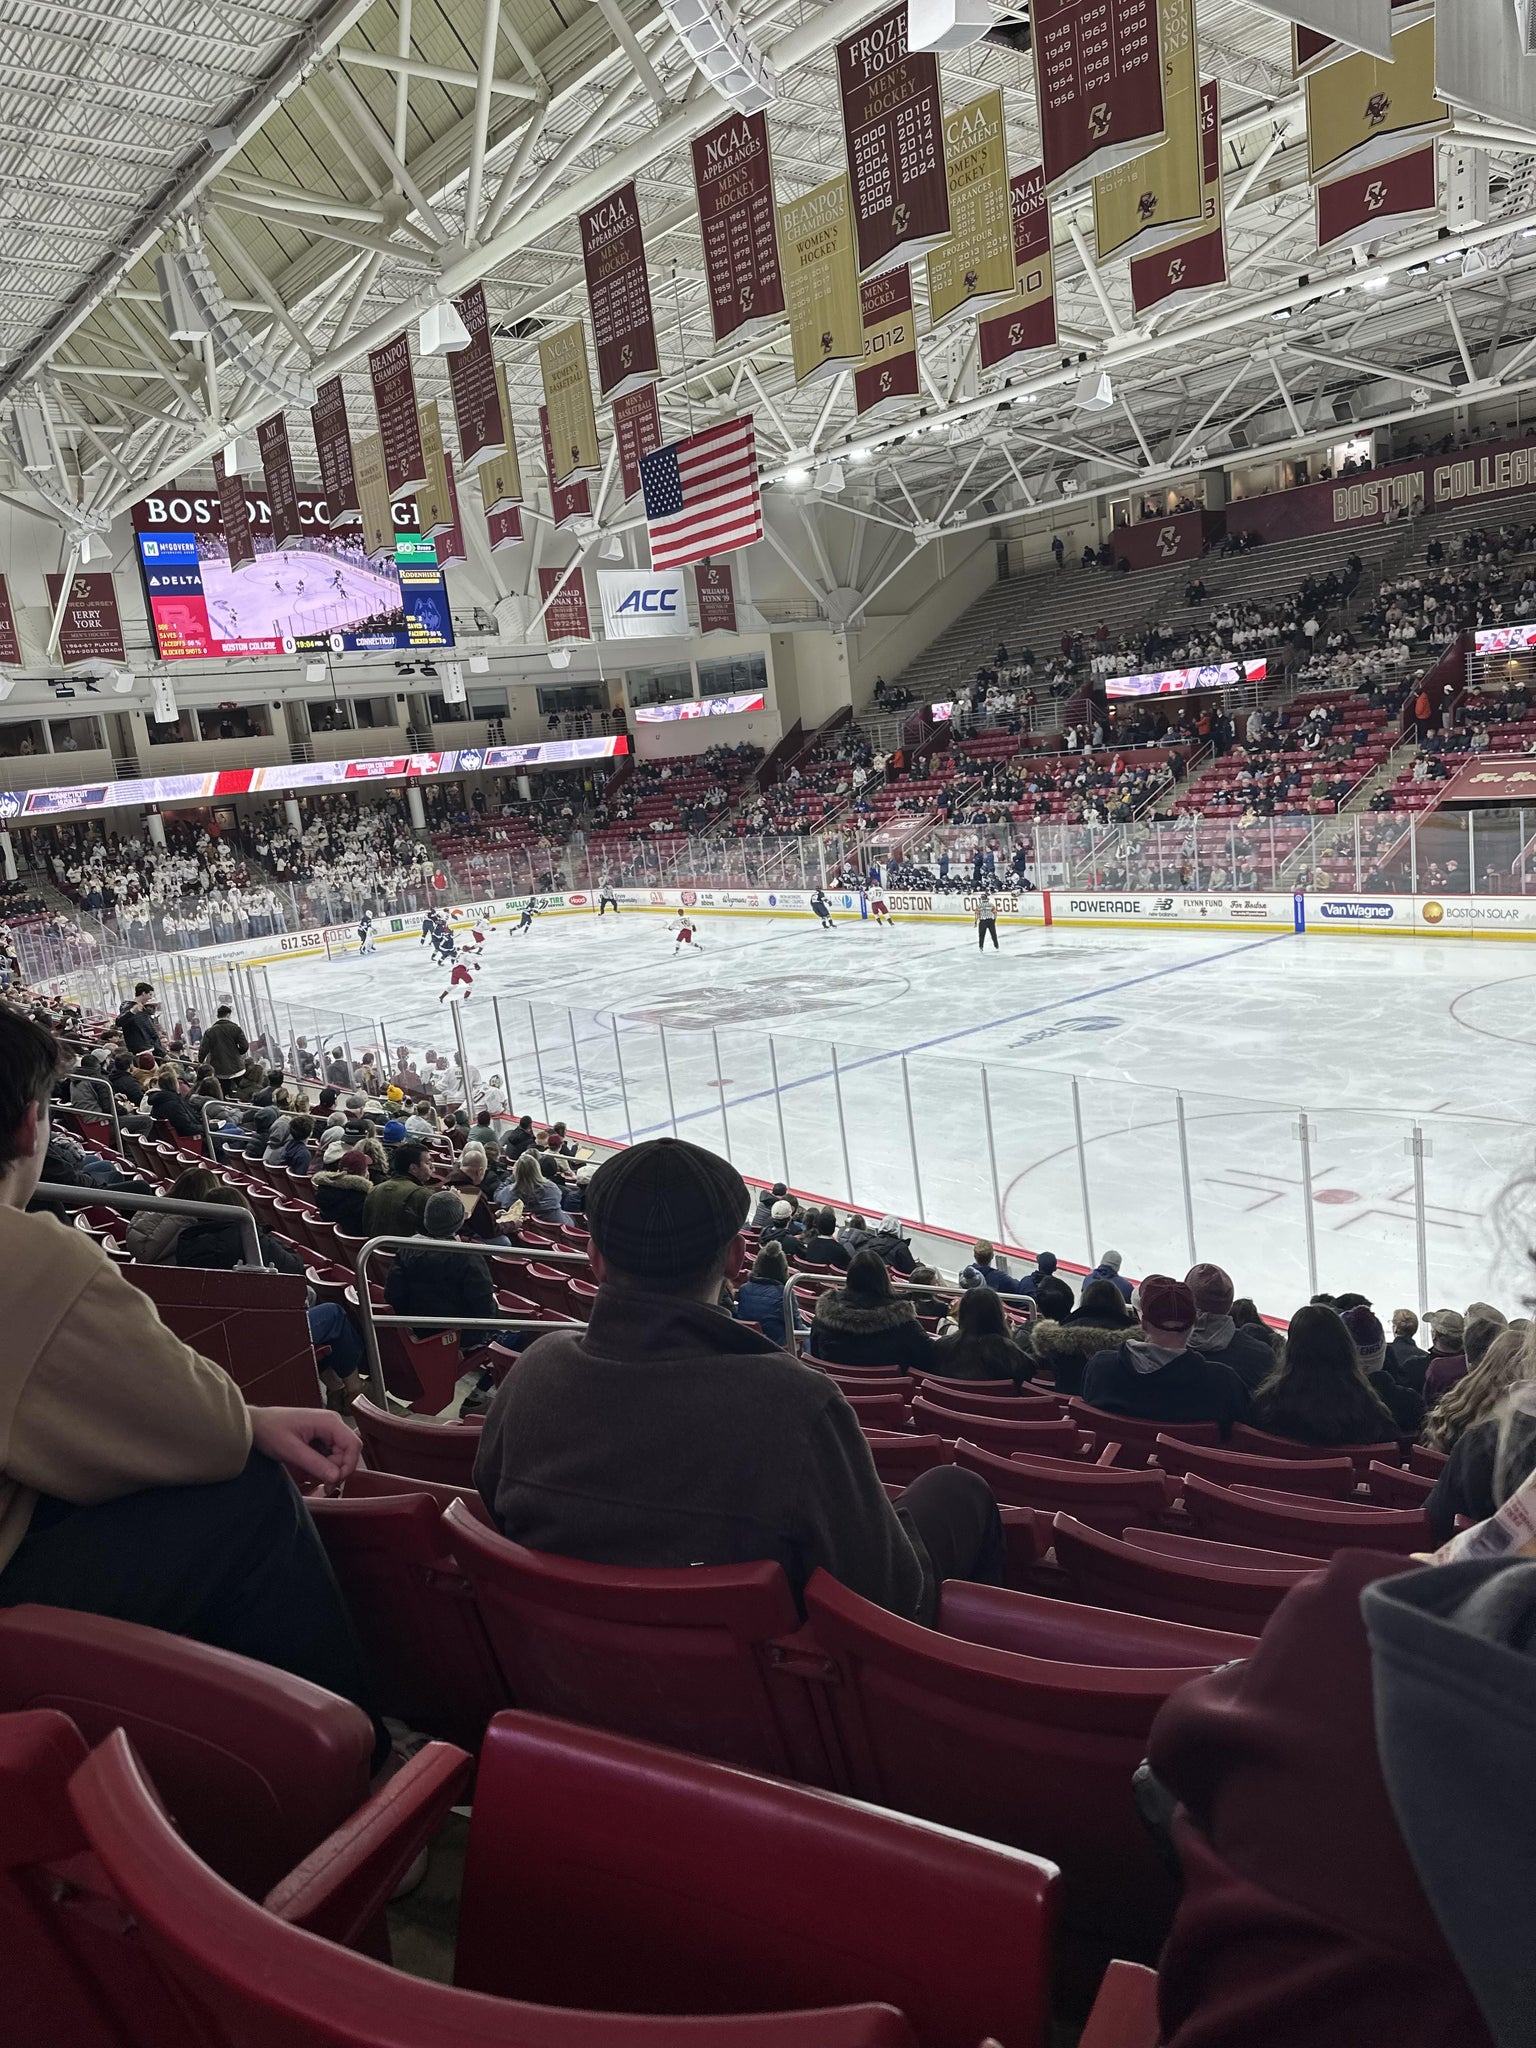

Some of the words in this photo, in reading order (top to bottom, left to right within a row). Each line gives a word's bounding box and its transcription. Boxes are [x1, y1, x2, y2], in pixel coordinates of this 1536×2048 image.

[1080, 5, 1106, 24] 1959
[1119, 1, 1146, 21] 1985
[1044, 24, 1070, 43] 1948
[1081, 22, 1107, 41] 1963
[1120, 18, 1147, 39] 1990
[849, 11, 908, 67] FROZE
[1083, 39, 1108, 57] 1965
[1121, 36, 1148, 56] 1998
[864, 38, 908, 78] FOUR
[1046, 41, 1071, 60] 1949
[1047, 58, 1072, 76] 1950
[1084, 56, 1109, 74] 1968
[1122, 53, 1149, 73] 1999
[868, 65, 907, 98] MEN'S
[1048, 74, 1074, 92] 1954
[1085, 73, 1110, 91] 1973
[864, 78, 915, 120] HOCKEY
[1050, 91, 1075, 108] 1956
[897, 99, 930, 126] 2010
[898, 114, 931, 140] 2012
[947, 108, 986, 144] CAA
[705, 121, 752, 165] NCAA
[855, 124, 885, 150] 2000
[900, 129, 933, 155] 2014
[946, 120, 999, 160] RNAMENT
[703, 138, 761, 181] APPEARANCES
[856, 140, 885, 164] 2001
[901, 144, 934, 169] 2016
[857, 153, 888, 178] 2004
[903, 158, 935, 184] 2024
[948, 147, 987, 178] OMEN'S
[718, 167, 748, 193] MEN'S
[859, 167, 890, 192] 2006
[950, 163, 986, 191] OCKEY
[1100, 173, 1137, 194] 2017-18
[715, 179, 755, 211] HOCKEY
[860, 181, 890, 205] 2007
[950, 180, 992, 207] EARANCES
[752, 197, 767, 211] 1986
[783, 184, 845, 232] BEANPOT
[862, 195, 892, 219] 2008
[589, 197, 628, 236] NCAA
[729, 210, 746, 223] 1965
[754, 209, 769, 223] 1987
[787, 204, 844, 241] CHAMPIONS
[587, 214, 635, 251] APPEARANCES
[707, 221, 724, 233] 1948
[731, 223, 747, 235] 1968
[709, 234, 725, 246] 1949
[732, 235, 748, 248] 1973
[756, 234, 772, 248] 1990
[796, 226, 838, 253] WOMEN'S
[942, 239, 970, 258] FROZEN
[972, 229, 993, 245] FOUR
[600, 239, 625, 261] MEN'S
[710, 246, 727, 258] 1950
[758, 248, 772, 261] 1991
[800, 240, 837, 266] HOCKEY
[599, 249, 631, 277] HOCKEY
[712, 258, 728, 270] 1954
[735, 260, 751, 272] 1984
[759, 260, 775, 274] 1998
[713, 271, 730, 282] 1956
[737, 273, 753, 285] 1985
[760, 273, 776, 286] 1999
[1018, 270, 1042, 296] 10
[714, 283, 731, 294] 1959
[864, 280, 890, 299] MEN'S
[716, 295, 732, 307] 1963
[862, 289, 895, 313] HOCKEY
[865, 326, 904, 356] 2012
[371, 340, 407, 372] BEANPOT
[374, 356, 408, 382] CHAMPIONS
[618, 400, 652, 420] BASKETBALL
[1333, 471, 1424, 523] BOSTON
[163, 576, 201, 584] DELTA
[616, 589, 678, 612] ACC
[72, 610, 100, 620] JERRY
[75, 620, 102, 628] YORK
[222, 643, 248, 652] BOSTON
[249, 642, 276, 650] COLLEGE
[357, 637, 395, 646] CONNECTICUT
[466, 906, 496, 918] nwn
[889, 896, 932, 911] BOSTON
[964, 897, 1019, 913] COEGE
[1070, 900, 1141, 913] POWERADE
[1326, 904, 1346, 915] Van
[1347, 906, 1391, 919] Wagner
[1446, 908, 1485, 918] BOSTON
[1487, 908, 1519, 919] SOLAR
